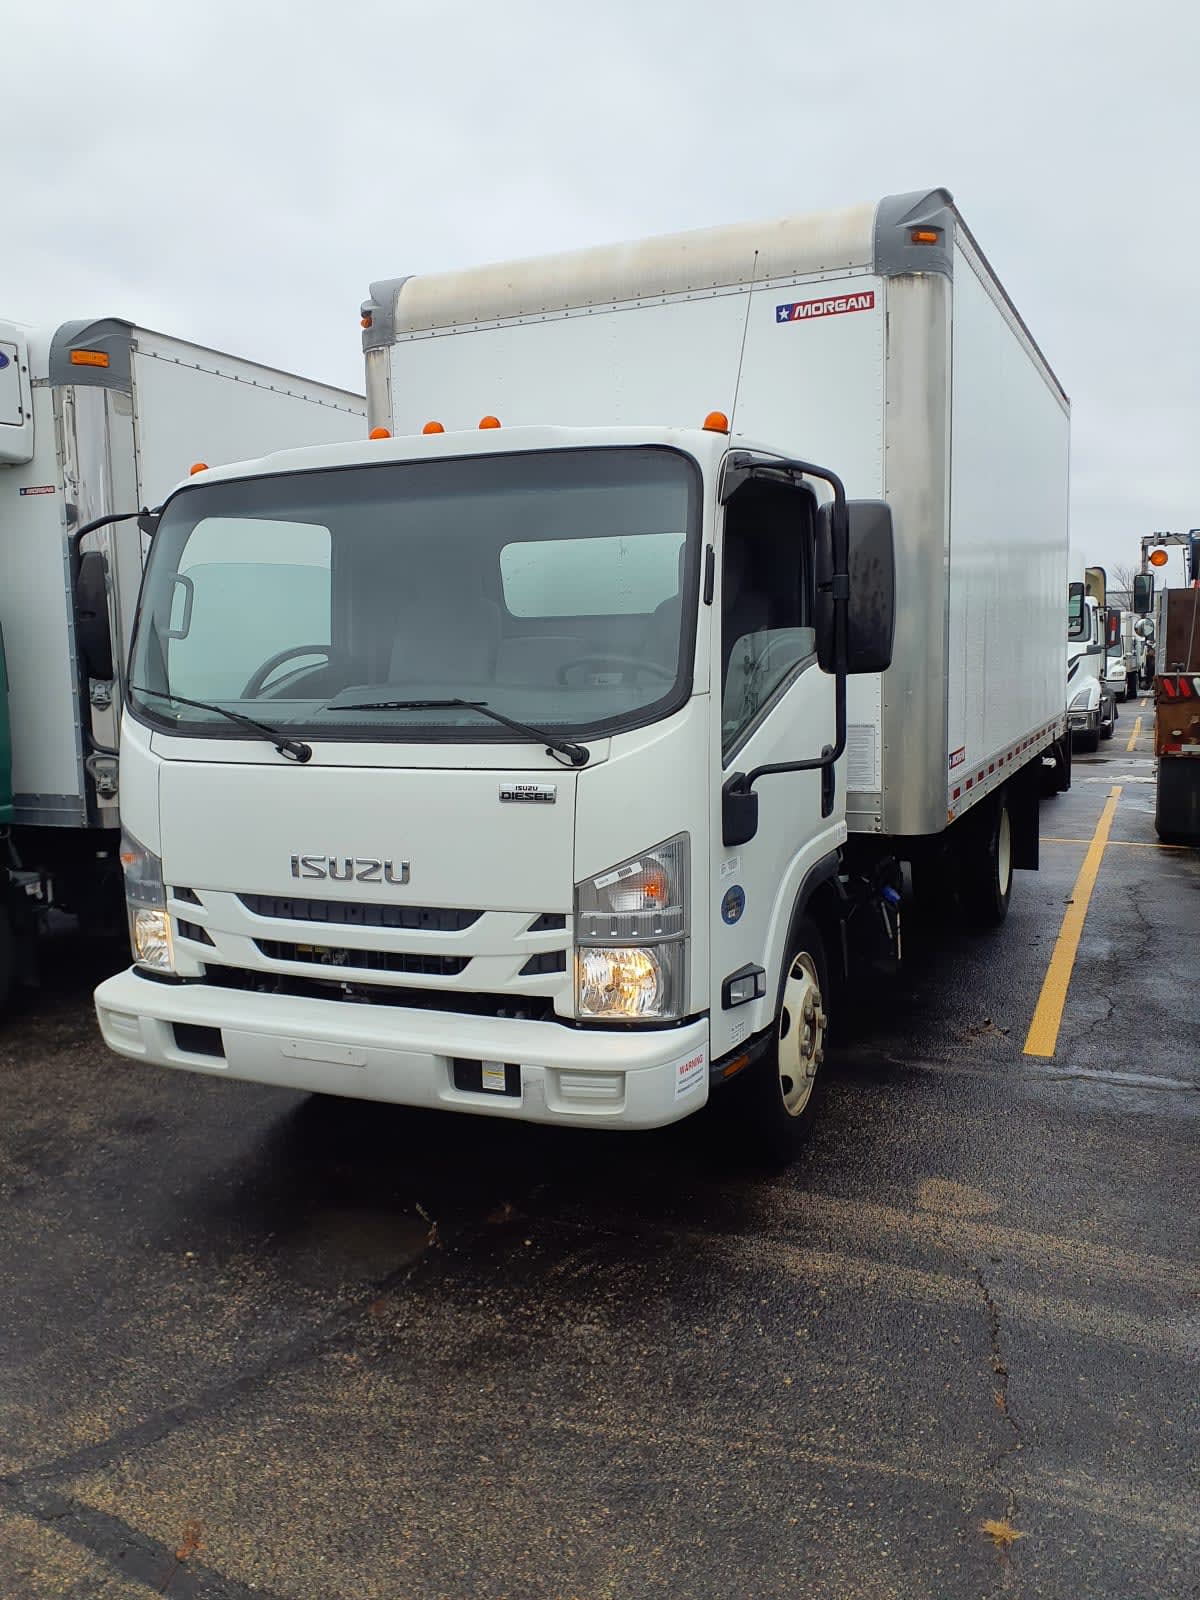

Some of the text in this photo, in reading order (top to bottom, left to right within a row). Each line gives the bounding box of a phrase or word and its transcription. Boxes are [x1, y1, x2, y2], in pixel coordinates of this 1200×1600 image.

[793, 295, 871, 318] MORGAN
[501, 791, 554, 801] DIESEL
[290, 854, 410, 885] ISUZU
